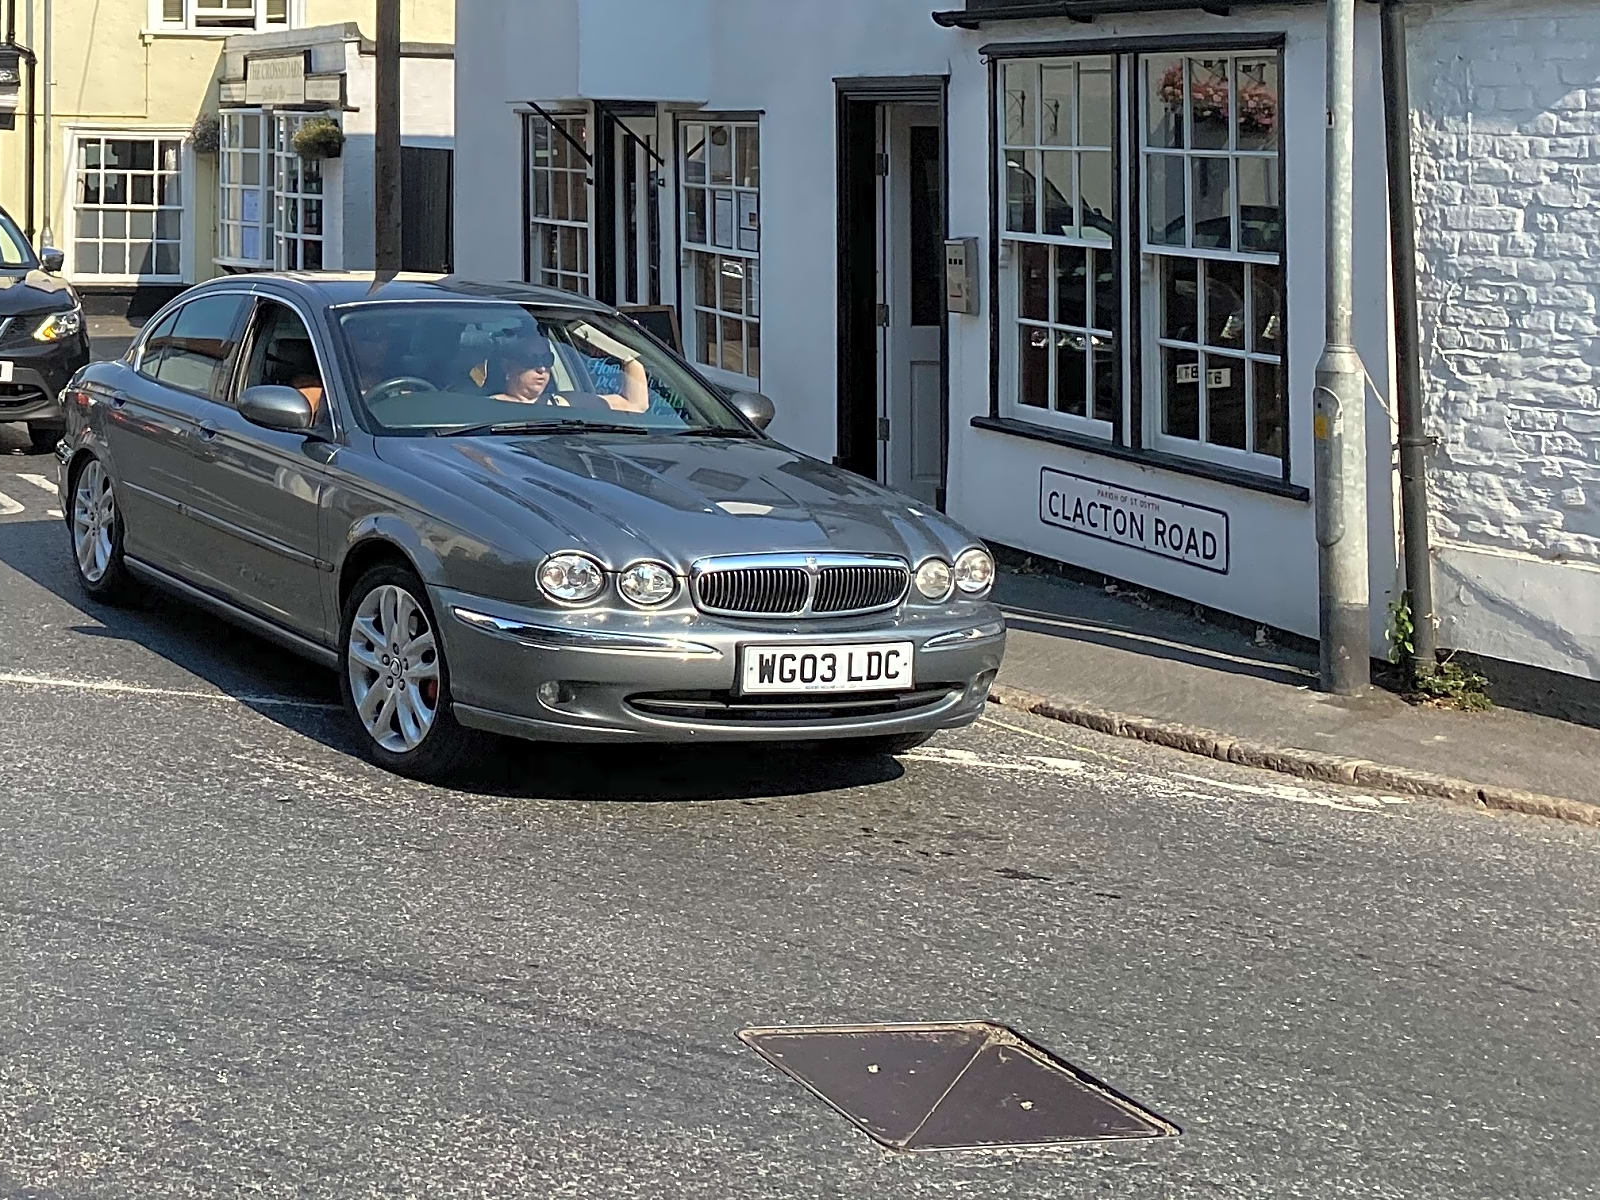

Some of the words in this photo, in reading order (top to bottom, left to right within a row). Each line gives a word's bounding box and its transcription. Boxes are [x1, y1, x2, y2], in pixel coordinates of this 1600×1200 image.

[1096, 489, 1119, 501] PARISH
[1119, 495, 1128, 503] OF
[1130, 497, 1138, 506] ST
[1139, 500, 1160, 511] OSYTH
[1048, 490, 1145, 542] CLACTON
[1154, 517, 1218, 561] ROAD
[758, 652, 838, 685] WG03
[846, 650, 901, 682] LDC
